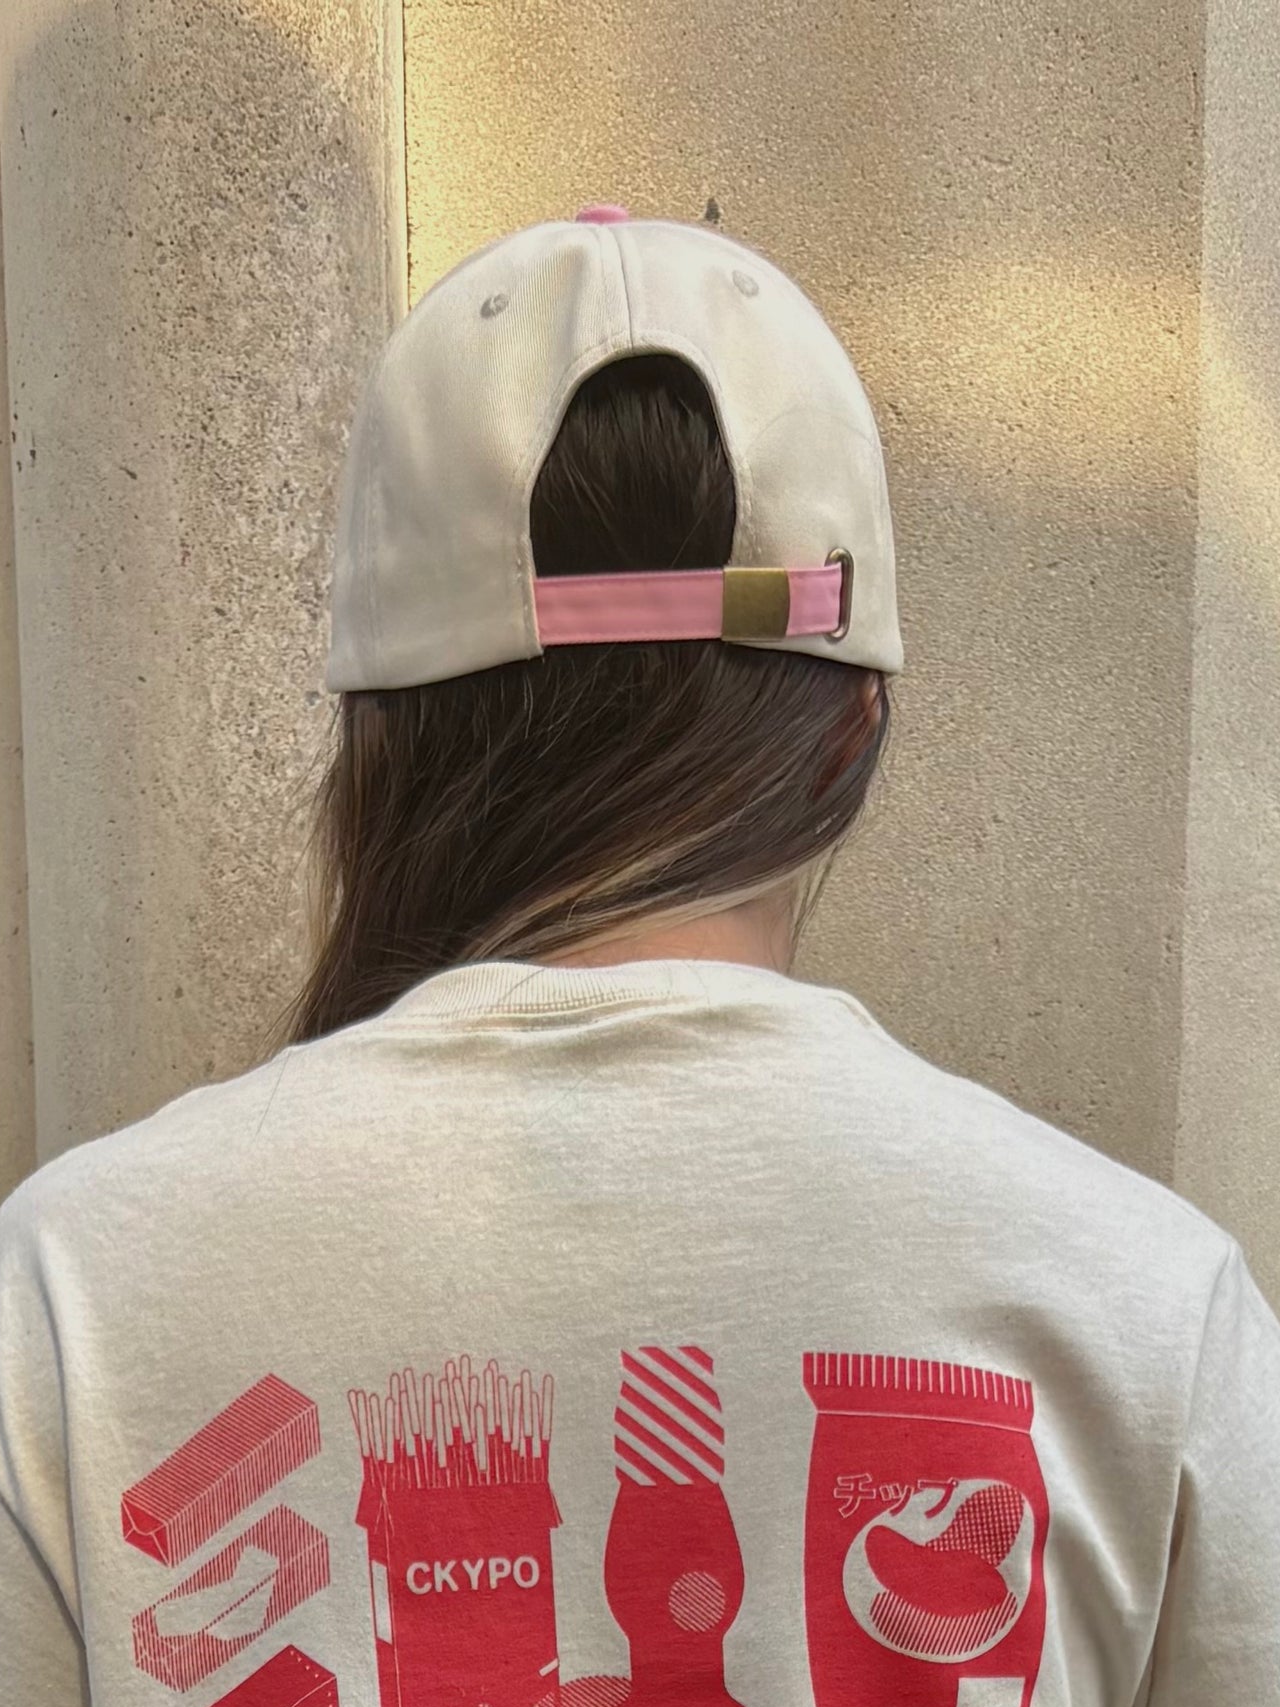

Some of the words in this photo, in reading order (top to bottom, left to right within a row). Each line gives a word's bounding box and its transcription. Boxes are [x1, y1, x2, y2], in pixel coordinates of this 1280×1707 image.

[833, 1472, 959, 1519] チップ
[405, 1555, 540, 1595] CKYPO
